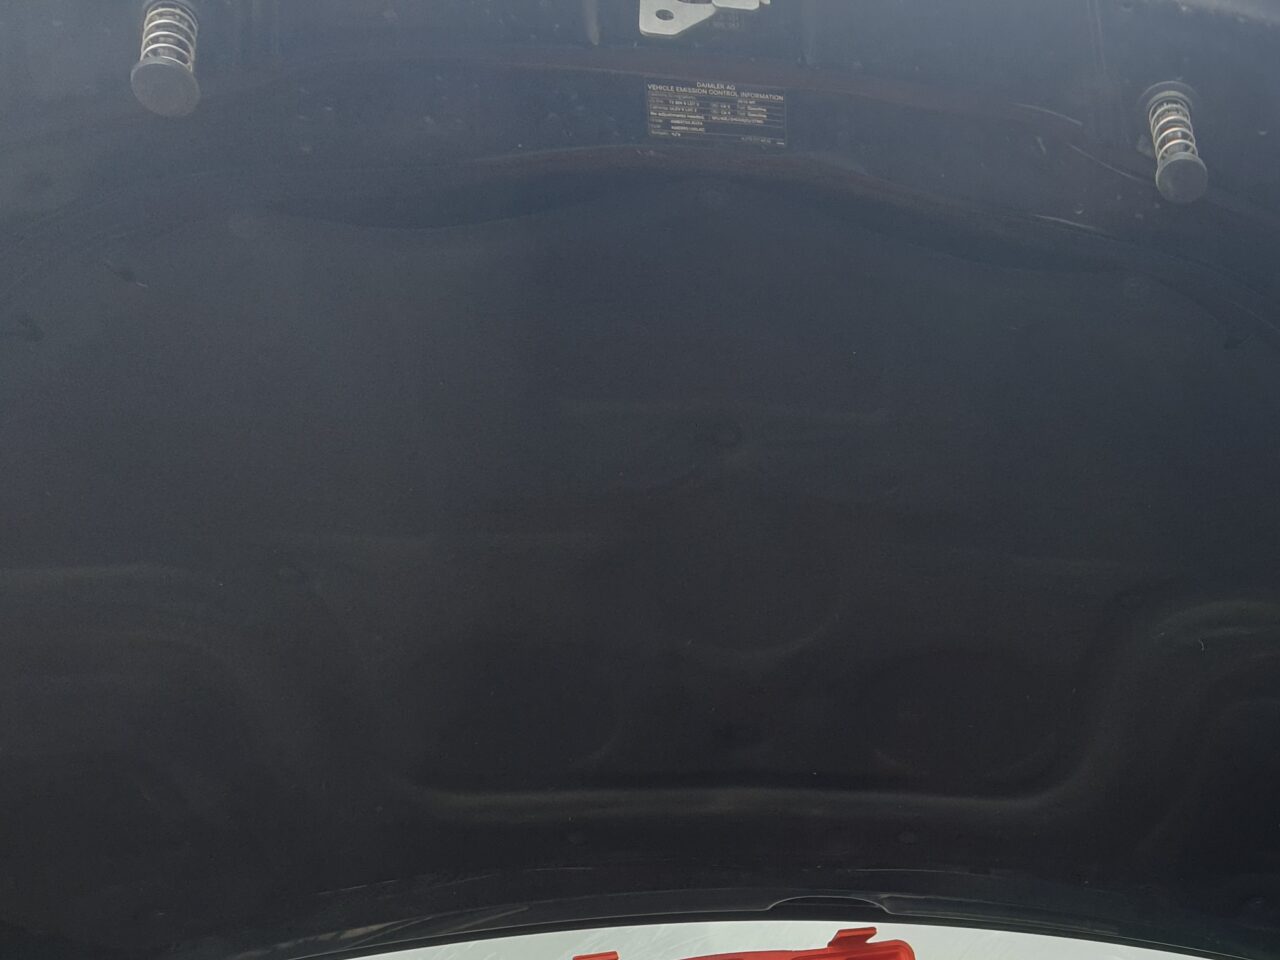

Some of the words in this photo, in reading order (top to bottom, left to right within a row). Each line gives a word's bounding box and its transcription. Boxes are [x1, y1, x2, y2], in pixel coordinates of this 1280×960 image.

[697, 81, 725, 90] DAIMLER
[647, 84, 675, 92] VEHICLE
[675, 86, 708, 95] EMISSION
[708, 89, 738, 97] CONTROL
[740, 92, 784, 101] INFORMATION
